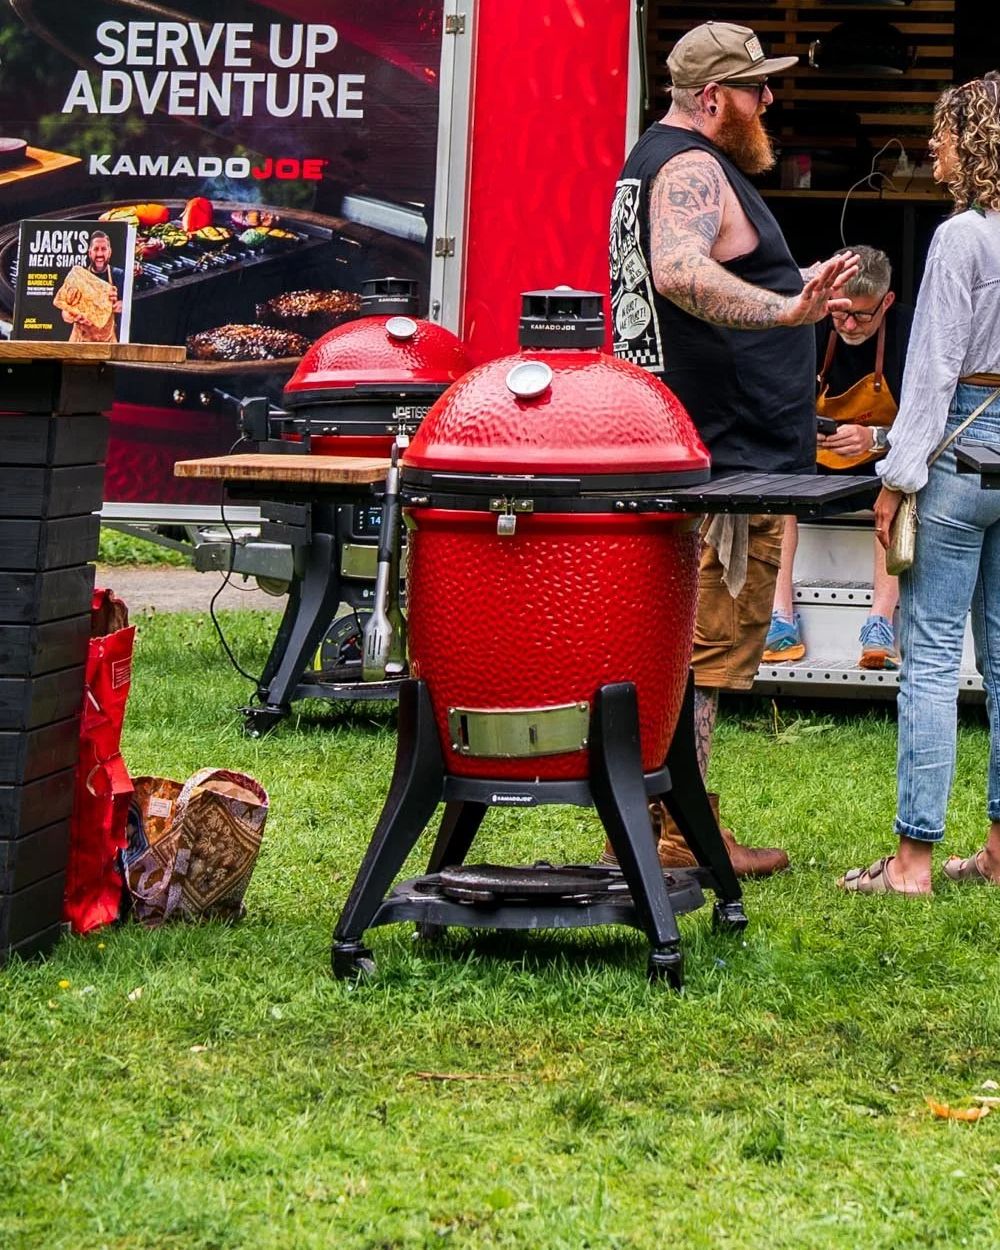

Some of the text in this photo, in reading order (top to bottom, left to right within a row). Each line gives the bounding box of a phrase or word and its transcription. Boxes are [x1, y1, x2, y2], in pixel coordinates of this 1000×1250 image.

[94, 20, 339, 69] SERVE UP
[61, 69, 366, 119] ADVENTURE
[30, 230, 89, 254] JACK'S
[28, 254, 87, 267] MEAT SHACK
